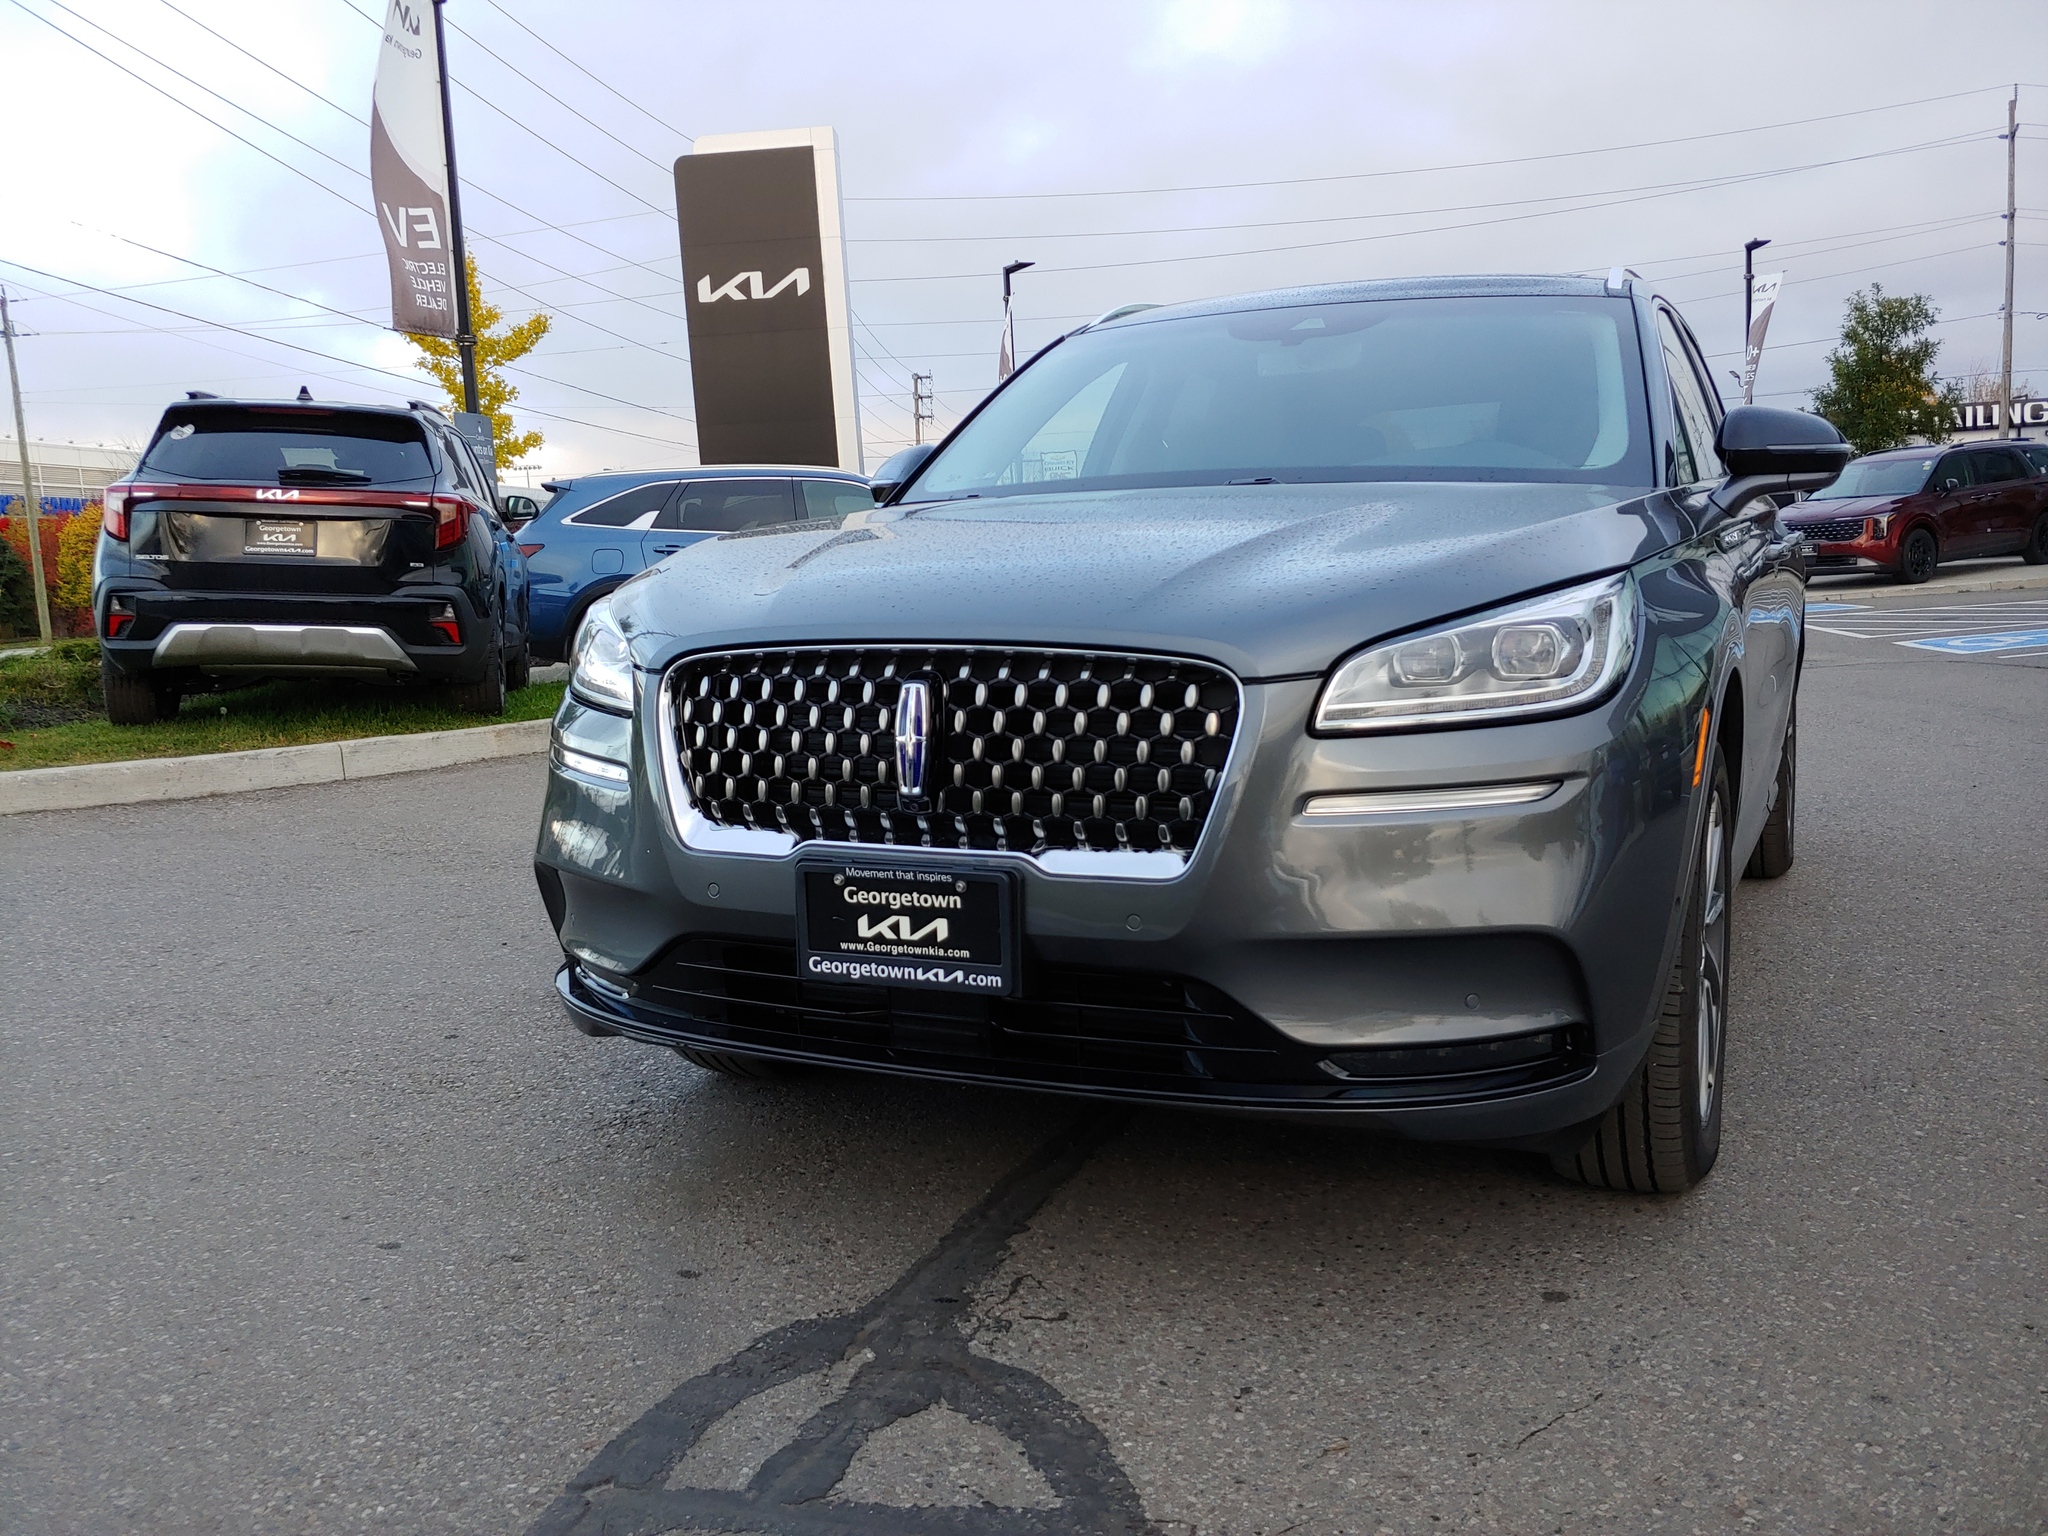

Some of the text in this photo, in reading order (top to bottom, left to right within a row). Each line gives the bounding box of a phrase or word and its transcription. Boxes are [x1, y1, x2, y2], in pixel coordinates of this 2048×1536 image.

[697, 267, 810, 303] KIA
[256, 489, 300, 500] KIA
[263, 533, 297, 542] KIA
[846, 867, 953, 884] Movement that inspires
[843, 886, 962, 910] Georgetown
[857, 913, 949, 943] KIA
[840, 941, 970, 959] www.Georgetownkia.com
